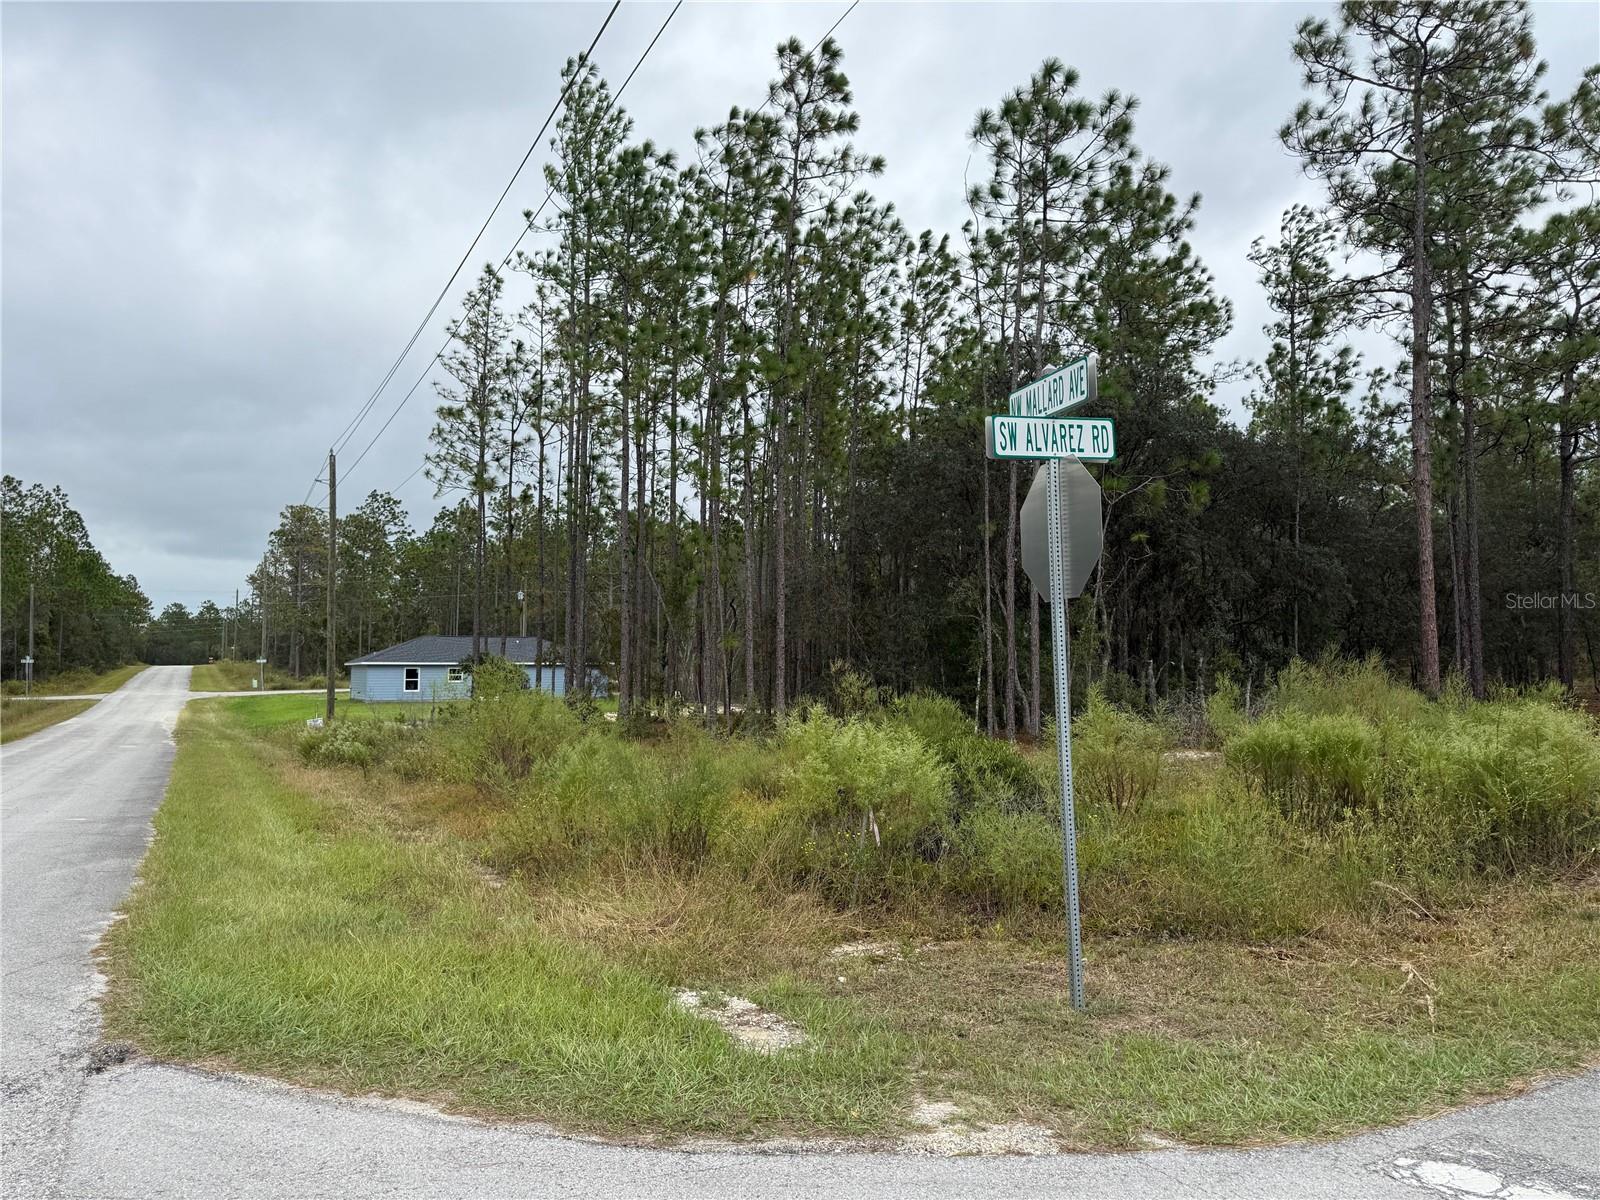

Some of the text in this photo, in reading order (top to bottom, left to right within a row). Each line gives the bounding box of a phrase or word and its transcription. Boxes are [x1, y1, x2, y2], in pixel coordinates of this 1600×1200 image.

[1026, 376, 1064, 416] MALLARD
[1069, 365, 1085, 401] AVE
[999, 421, 1109, 453] SW ALVAREZ RD
